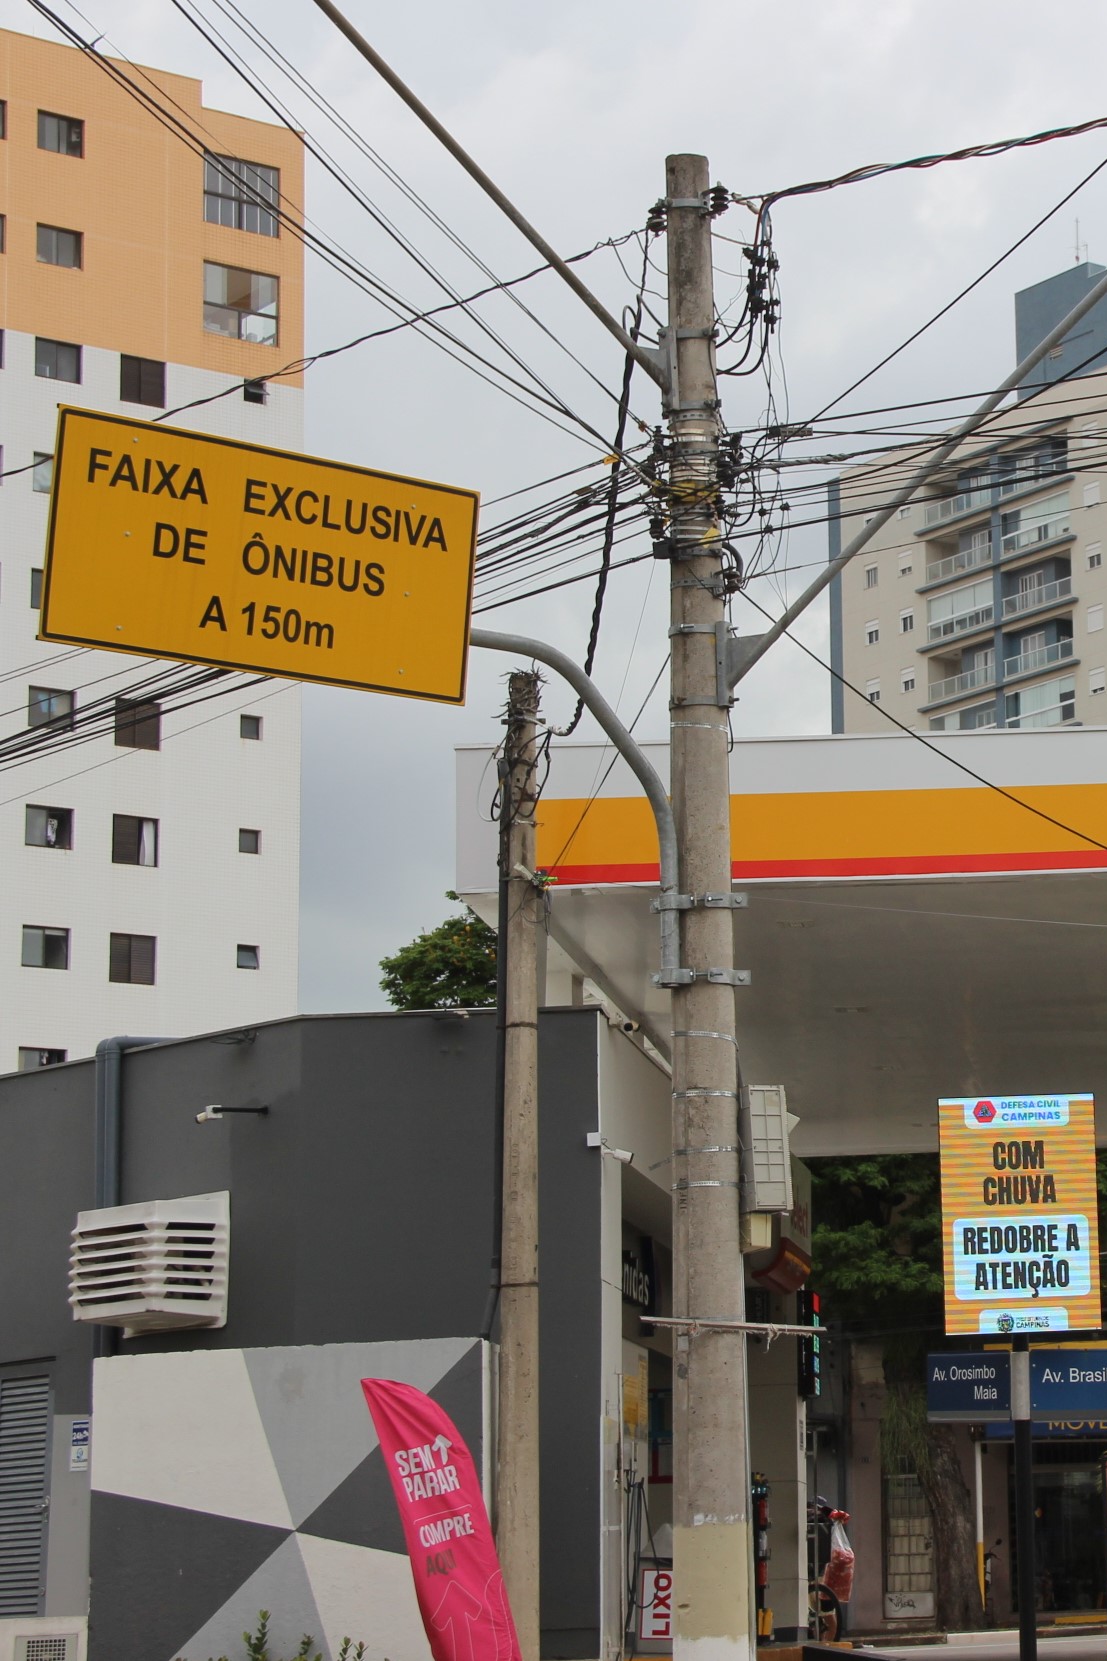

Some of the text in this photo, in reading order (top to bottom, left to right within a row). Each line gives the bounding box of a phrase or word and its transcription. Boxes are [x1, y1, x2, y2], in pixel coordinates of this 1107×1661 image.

[87, 447, 448, 552] FAIXA EXCLUSIVA
[152, 521, 386, 597] DE ÔNIBUS
[198, 595, 335, 649] A 150m
[1000, 1100, 1060, 1109] DEFESA CIVIL
[1001, 1111, 1061, 1121] CAMPINAS
[992, 1140, 1045, 1171] COM
[983, 1174, 1057, 1206] CHUVA
[962, 1223, 1080, 1255] REDOBRE A
[623, 1251, 649, 1306] nidas
[974, 1254, 1070, 1298] ATENÇÃO
[1016, 1320, 1050, 1329] CAMPINAS
[933, 1365, 996, 1381] Av. Orosimbo
[1042, 1368, 1064, 1383] Av.
[974, 1385, 998, 1400] Maia
[395, 1444, 436, 1476] SEM
[402, 1465, 461, 1503] PARAR
[420, 1513, 475, 1548] COMPRE
[426, 1549, 457, 1578] AQUI
[652, 1573, 672, 1636] LIXO
